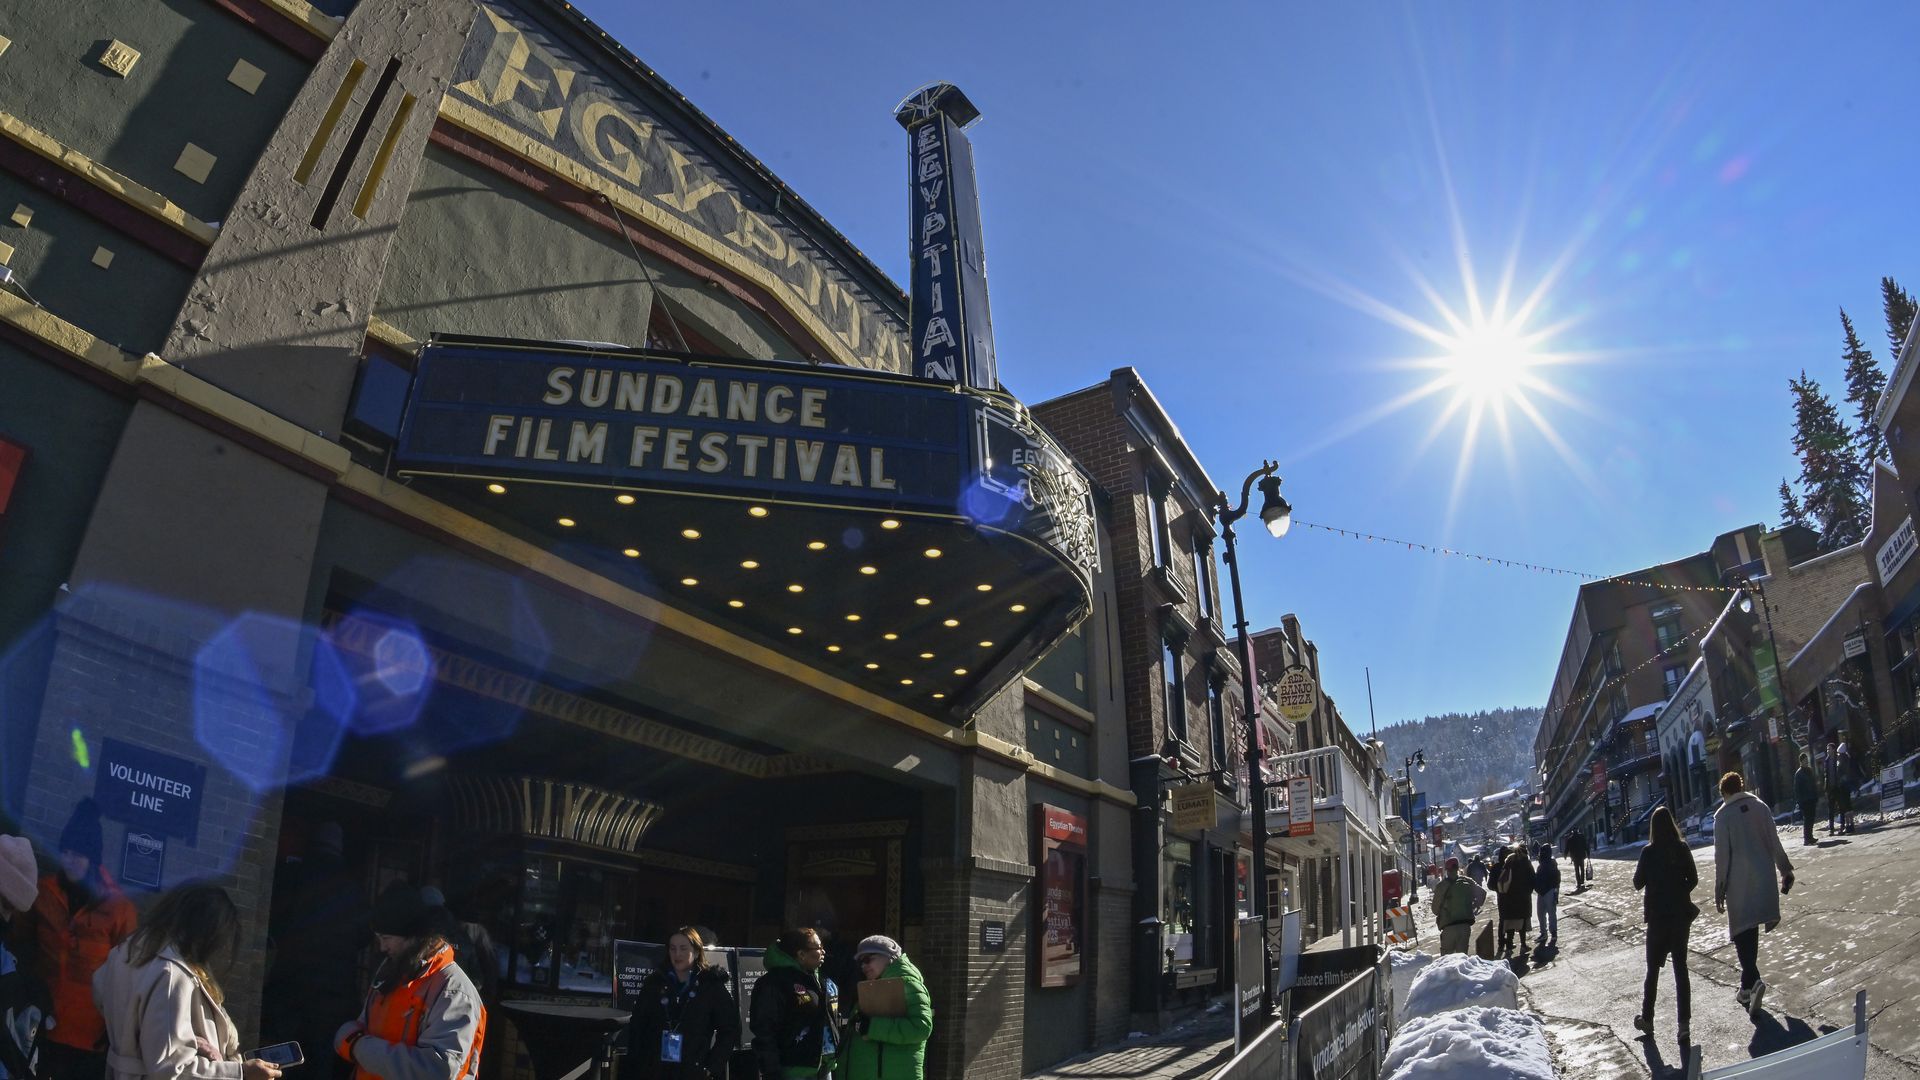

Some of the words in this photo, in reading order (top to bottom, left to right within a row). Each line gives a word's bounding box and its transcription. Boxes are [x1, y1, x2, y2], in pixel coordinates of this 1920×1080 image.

[454, 3, 912, 376] EGYPTIA
[917, 124, 957, 380] EGYPTIAN
[542, 366, 828, 429] SUNDANCE
[483, 414, 609, 465] FILM
[628, 425, 897, 491] FESTIVAL
[1287, 673, 1304, 684] RED
[1280, 683, 1313, 696] BANJO
[1280, 694, 1313, 707] PIZZA
[109, 761, 192, 800] VOLUNTEER
[131, 791, 165, 813] LINE
[1049, 817, 1069, 831] Egyptian
[1068, 822, 1084, 835] Theatre
[1046, 915, 1071, 927] estival
[618, 973, 642, 981] COMFORT
[1296, 973, 1324, 987] undance
[1324, 971, 1340, 985] film
[1313, 1033, 1345, 1074] undance
[1345, 1021, 1358, 1049] film
[1357, 1007, 1375, 1038] festiva
